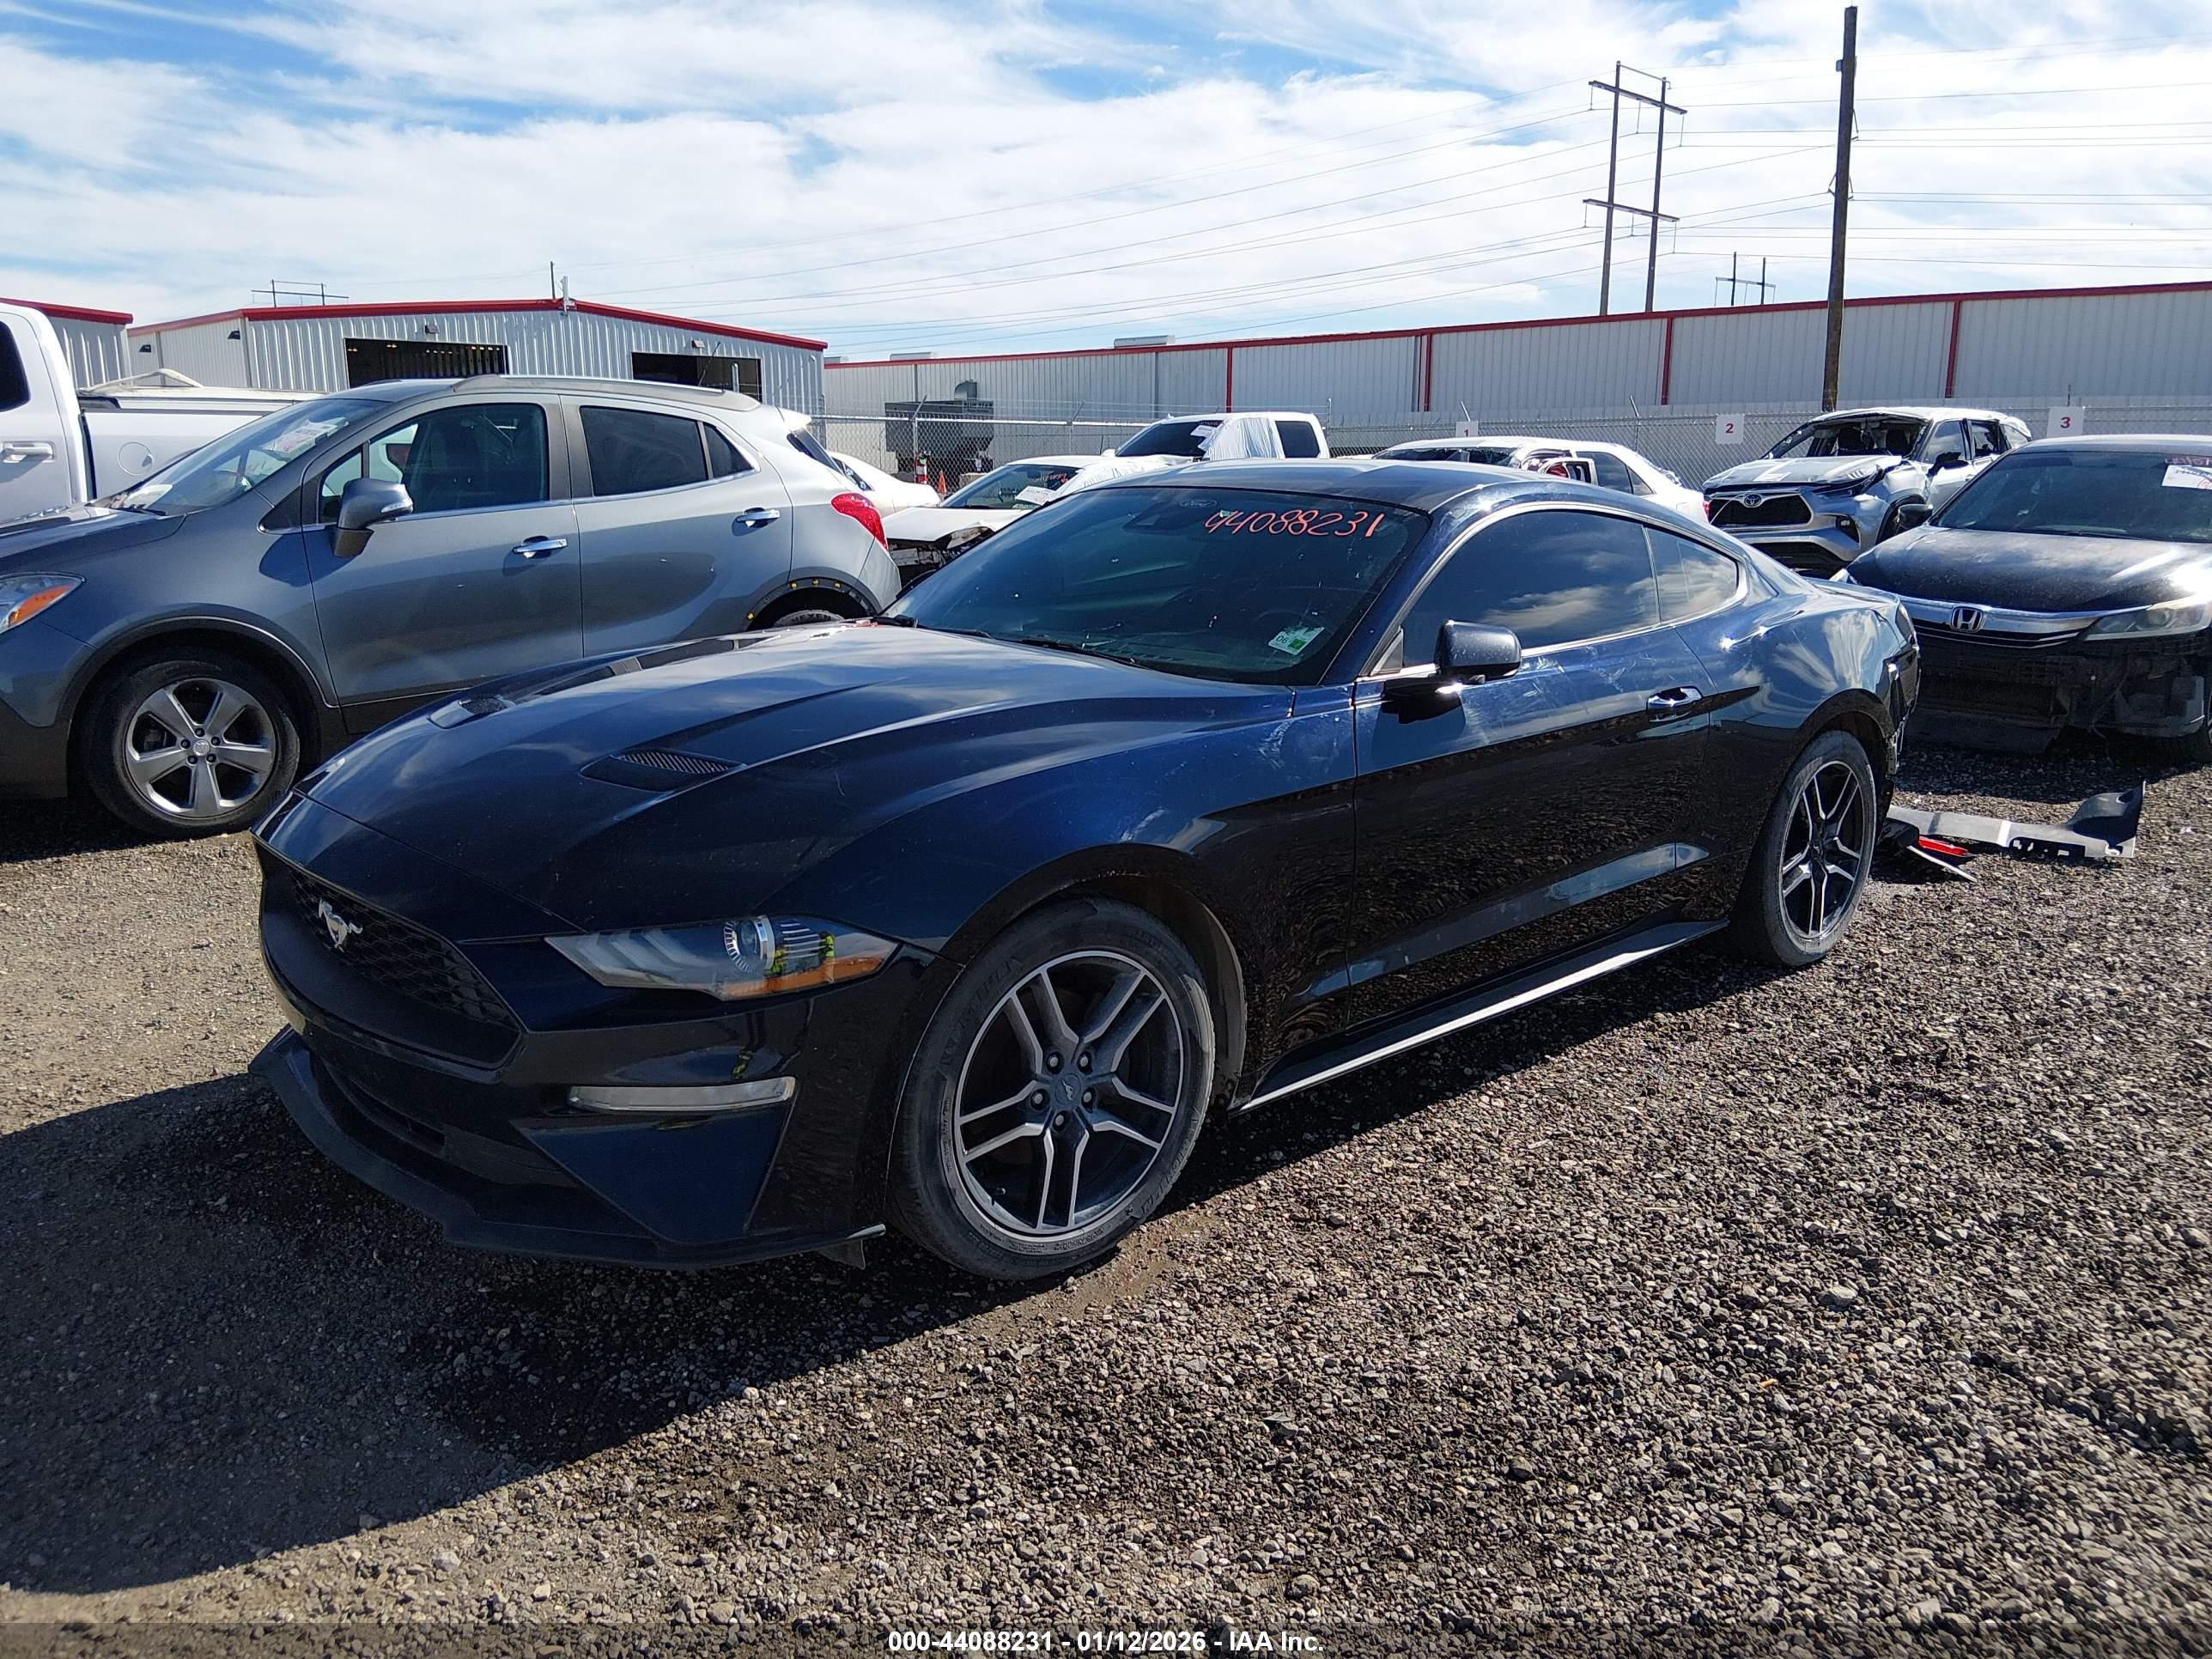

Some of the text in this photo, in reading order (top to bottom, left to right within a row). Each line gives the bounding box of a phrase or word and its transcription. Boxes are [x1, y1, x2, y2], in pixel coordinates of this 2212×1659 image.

[1725, 422, 1734, 434] 2
[2060, 416, 2070, 428] 3
[1463, 428, 1469, 437] 1
[1204, 508, 1386, 538] 44088231
[1276, 635, 1290, 644] 06
